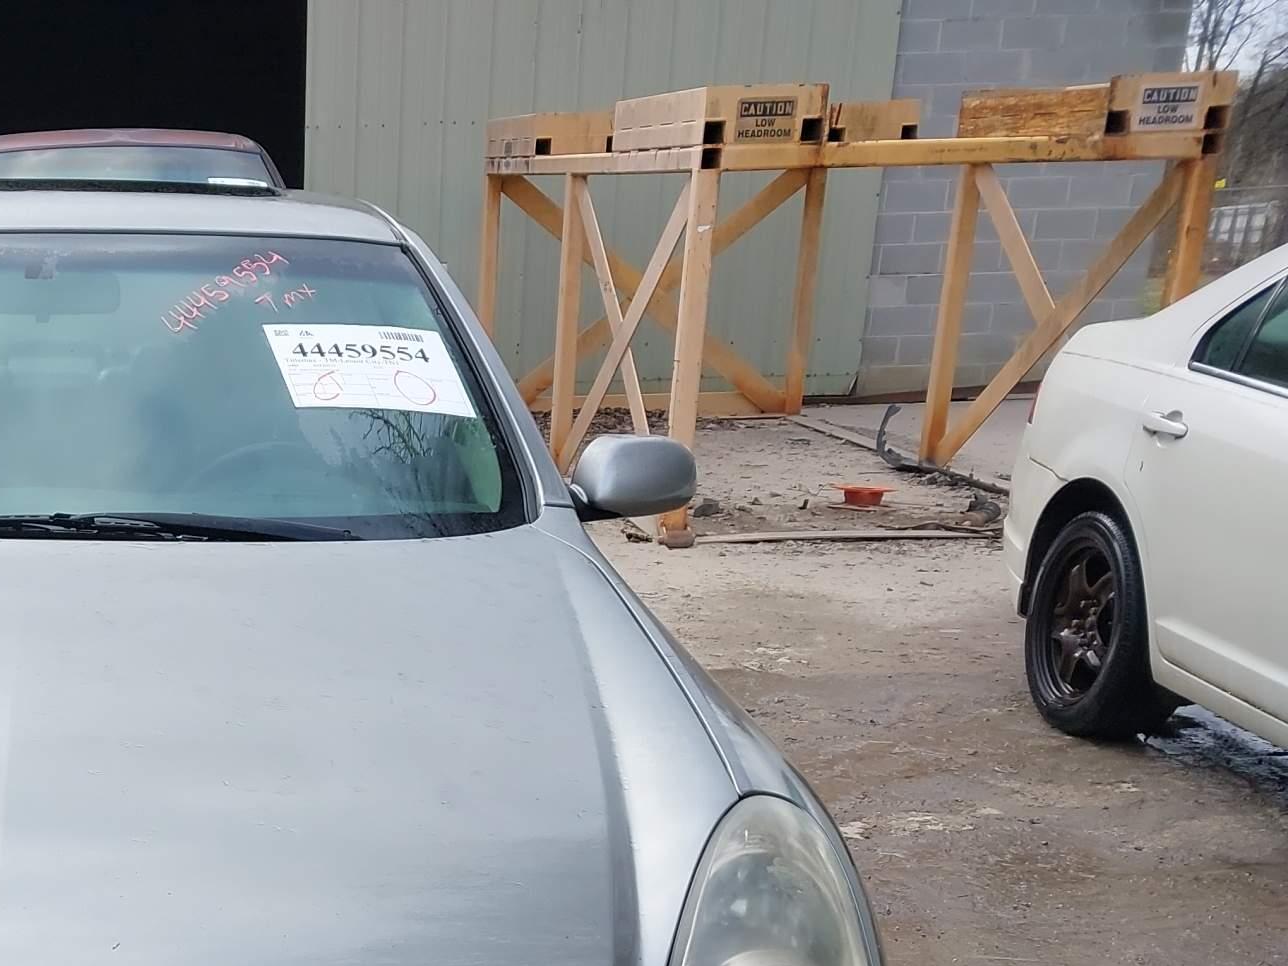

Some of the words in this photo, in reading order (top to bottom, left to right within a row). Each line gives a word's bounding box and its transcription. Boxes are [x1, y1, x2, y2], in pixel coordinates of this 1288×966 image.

[1144, 88, 1198, 102] CAUTION
[742, 102, 793, 115] CAUTION
[1157, 105, 1178, 114] LOW
[755, 118, 776, 127] LOW
[1138, 114, 1194, 125] HEADROOM
[737, 128, 791, 138] HEADROOM
[160, 250, 289, 332] 44459554
[292, 341, 431, 364] 44459554
